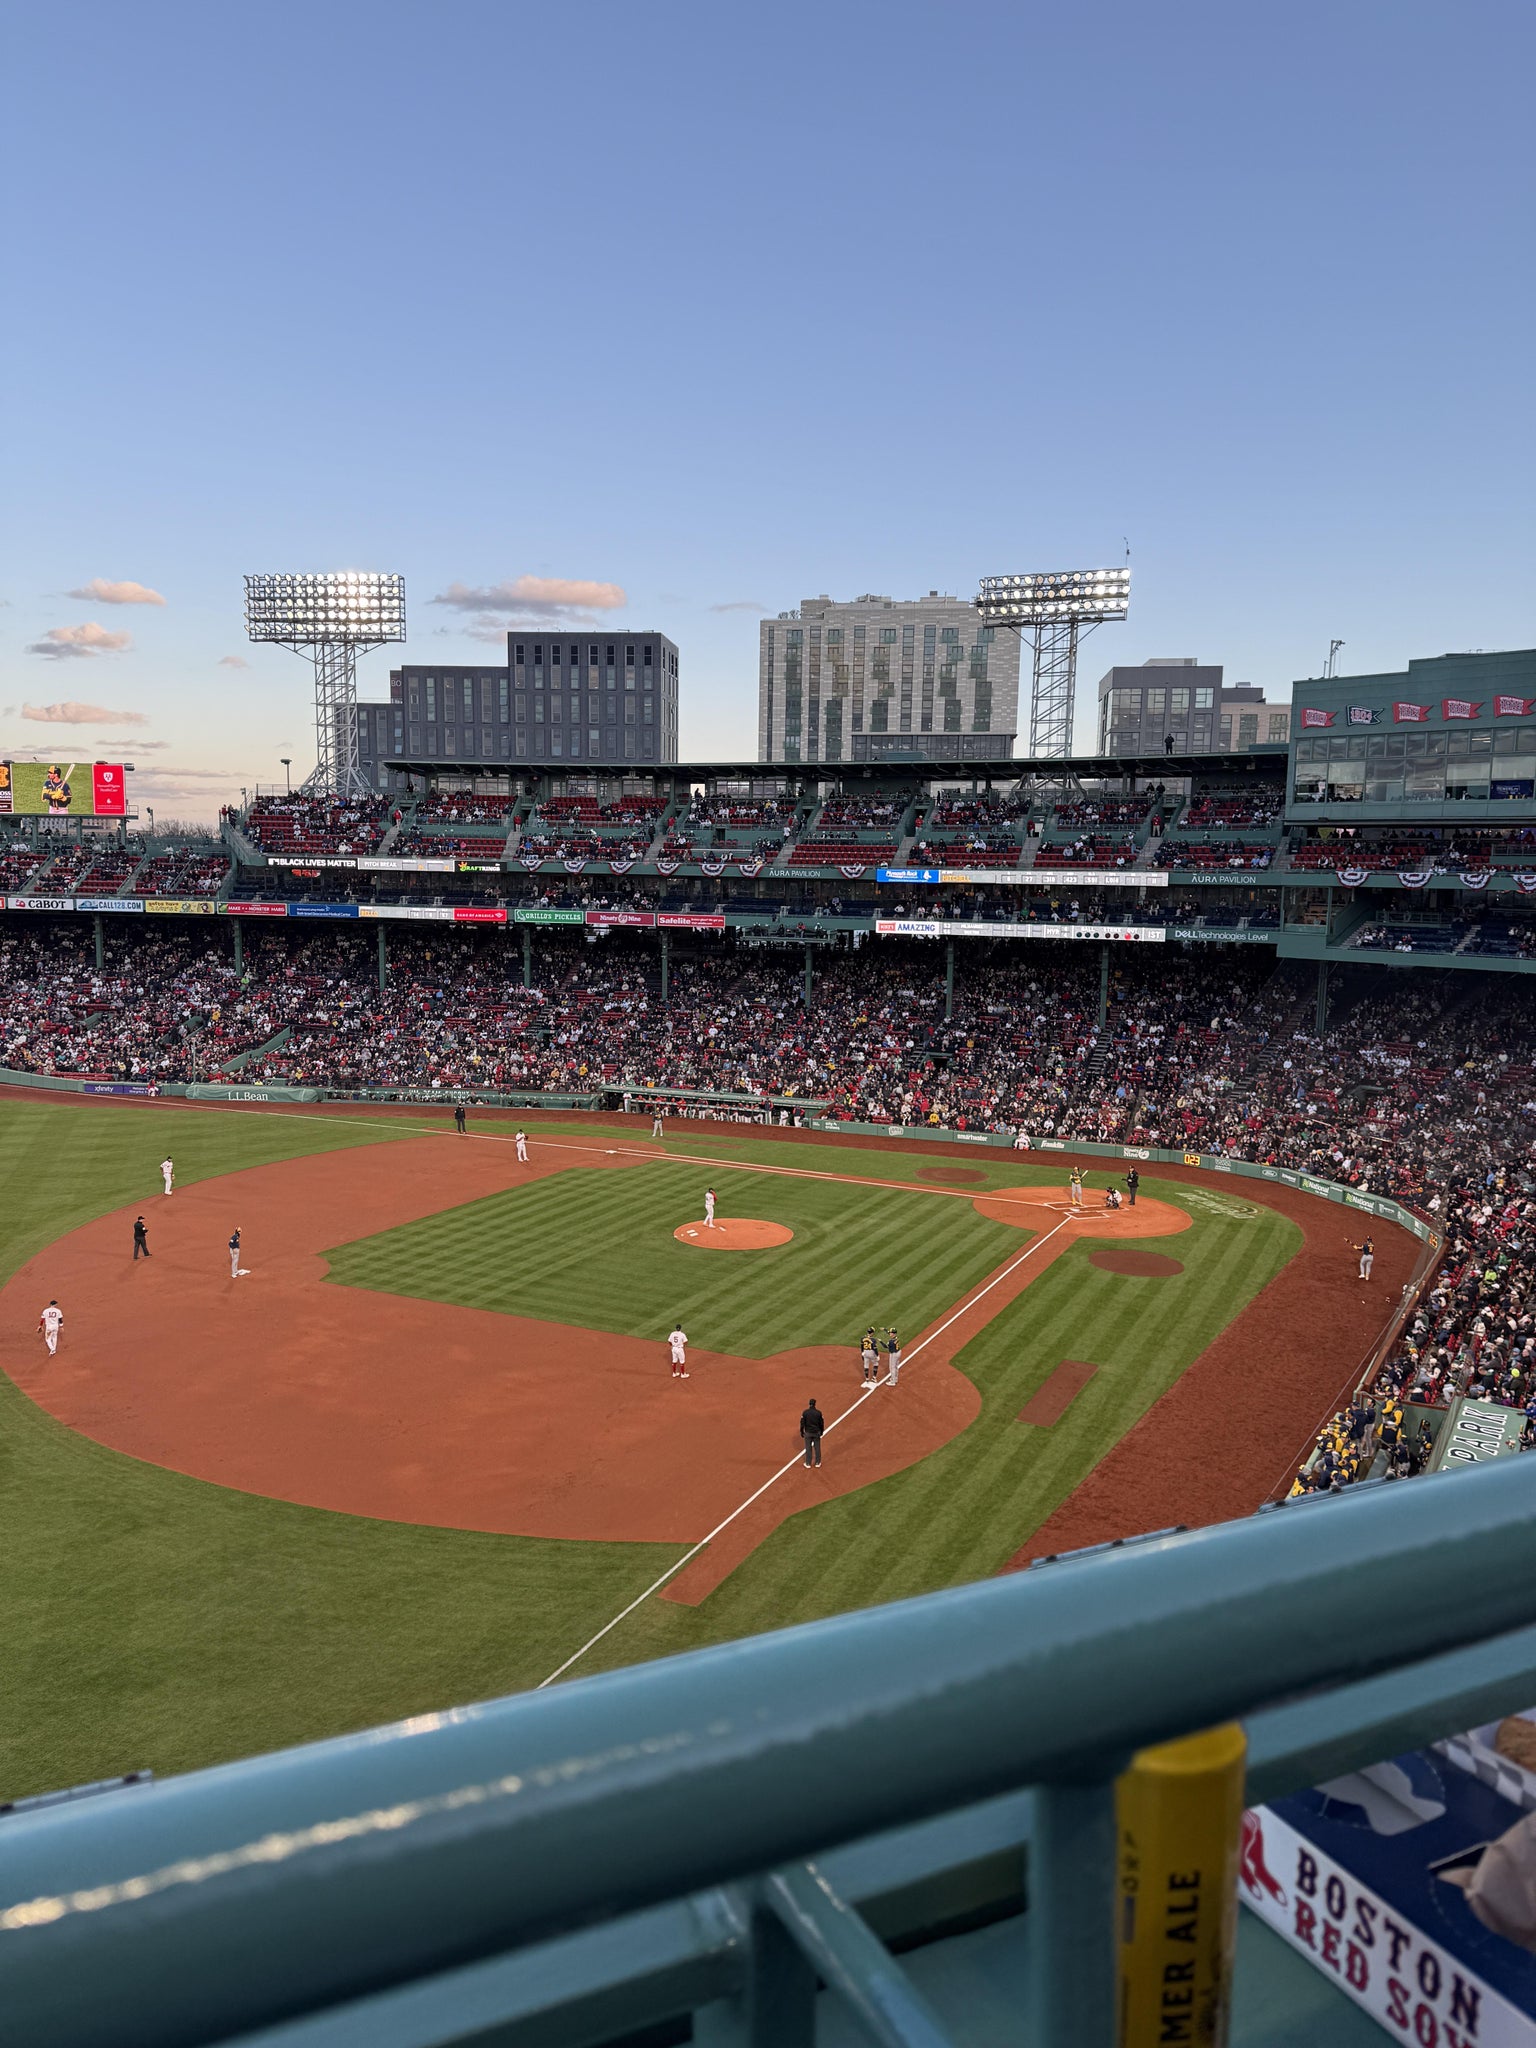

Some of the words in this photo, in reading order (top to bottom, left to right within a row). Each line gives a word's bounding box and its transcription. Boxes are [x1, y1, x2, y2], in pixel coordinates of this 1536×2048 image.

[280, 858, 304, 866] BLACK
[305, 859, 326, 867] LIVES
[327, 859, 356, 867] MATTER
[1219, 875, 1256, 884] PAVILION
[99, 901, 141, 909] CALL128.COM
[600, 914, 618, 922] Ninety
[659, 917, 691, 925] Safelite
[897, 923, 936, 932] AMAZING
[1175, 930, 1198, 938] DELL
[1198, 931, 1246, 941] Technologies
[1248, 933, 1268, 941] Level
[94, 1085, 114, 1093] xfinity
[228, 1092, 268, 1101] L.L.Bean
[957, 1133, 988, 1142] smartwater
[1308, 1180, 1330, 1194] National
[1352, 1193, 1375, 1208] National
[673, 1336, 679, 1344] 5
[863, 1342, 872, 1350] 24
[1447, 1406, 1508, 1463] PARK
[1165, 1868, 1201, 1944] ALE
[1294, 1895, 1370, 1993] RED
[1296, 1846, 1483, 2038] BOSTON
[1158, 1959, 1196, 2048] MER
